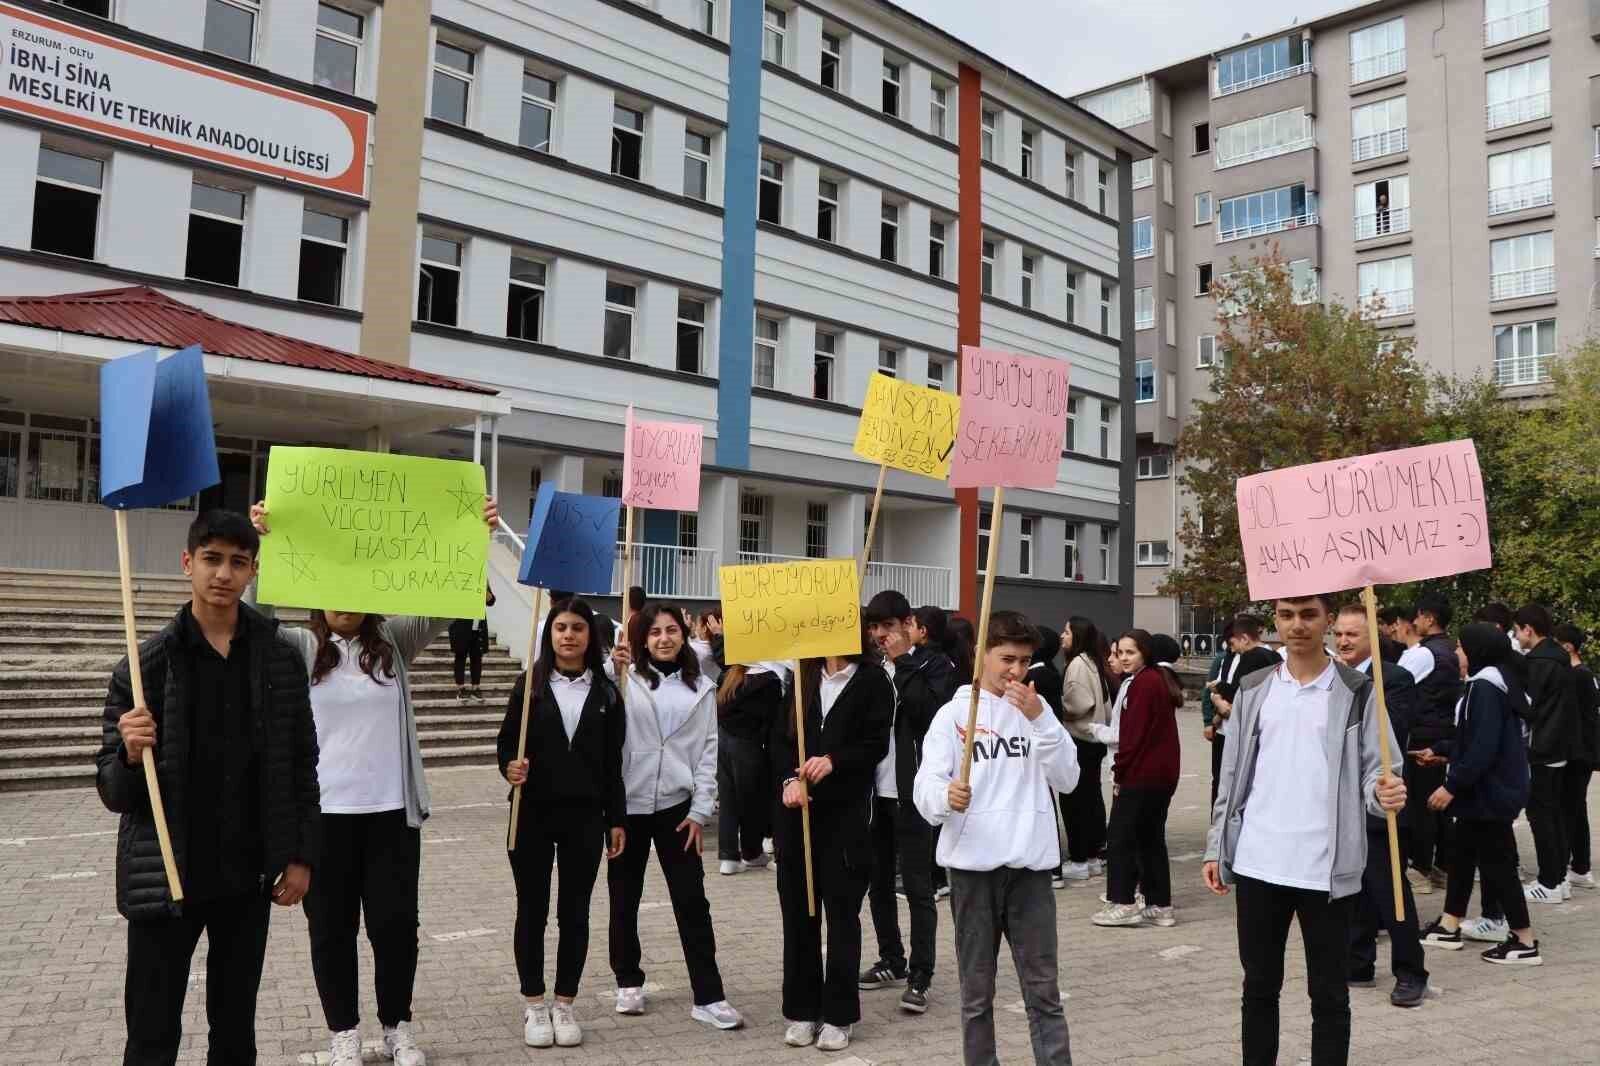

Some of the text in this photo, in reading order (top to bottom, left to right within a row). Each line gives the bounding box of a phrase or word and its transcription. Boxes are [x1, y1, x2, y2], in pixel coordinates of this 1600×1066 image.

[12, 28, 62, 50] ERZURUM
[69, 46, 94, 59] OLTU
[11, 42, 112, 92] İBN-İ SİNA
[9, 72, 331, 173] MESLEKİ VE TEKNİK ANADOLU LİSESİ
[280, 459, 408, 504] YÜRÜYEN
[1244, 451, 1482, 530] YOL YÜRÜMEKLE
[321, 503, 432, 536] VÜCUTTA
[354, 535, 475, 566] HASTALIK
[1257, 538, 1311, 574] AYAK
[372, 562, 485, 595] DURMAZ!
[723, 563, 854, 602] YÜRÜYORUM
